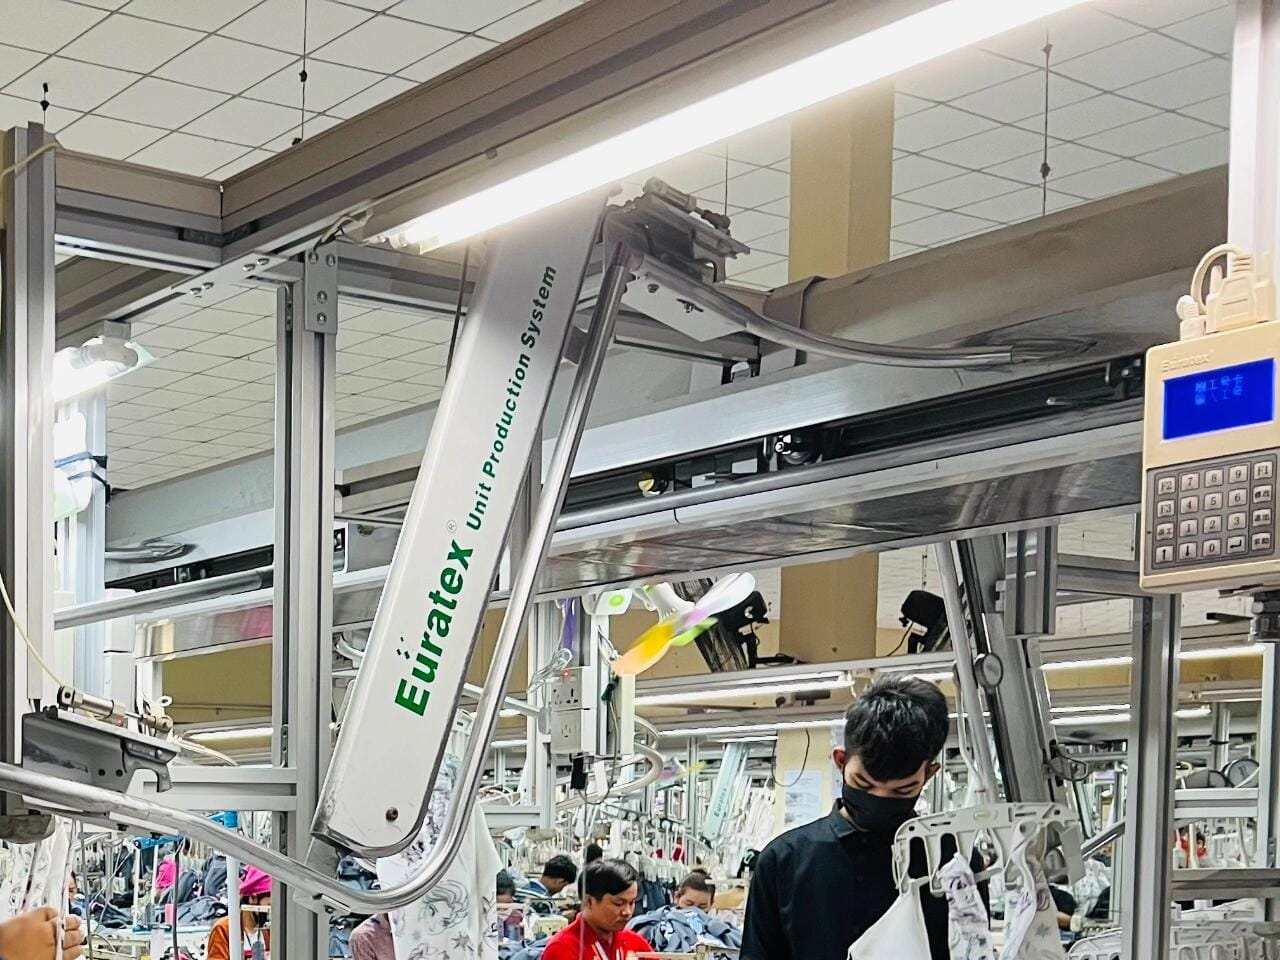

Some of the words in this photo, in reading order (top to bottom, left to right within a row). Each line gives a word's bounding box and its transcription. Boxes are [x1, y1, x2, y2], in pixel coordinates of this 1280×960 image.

[395, 539, 473, 717] Euratex
[466, 481, 492, 530] Unit
[483, 353, 531, 478] Production
[521, 265, 557, 348] System
[1210, 496, 1217, 506] 5
[1234, 493, 1241, 503] 6
[1209, 520, 1216, 530] 2
[1233, 516, 1240, 526] 3
